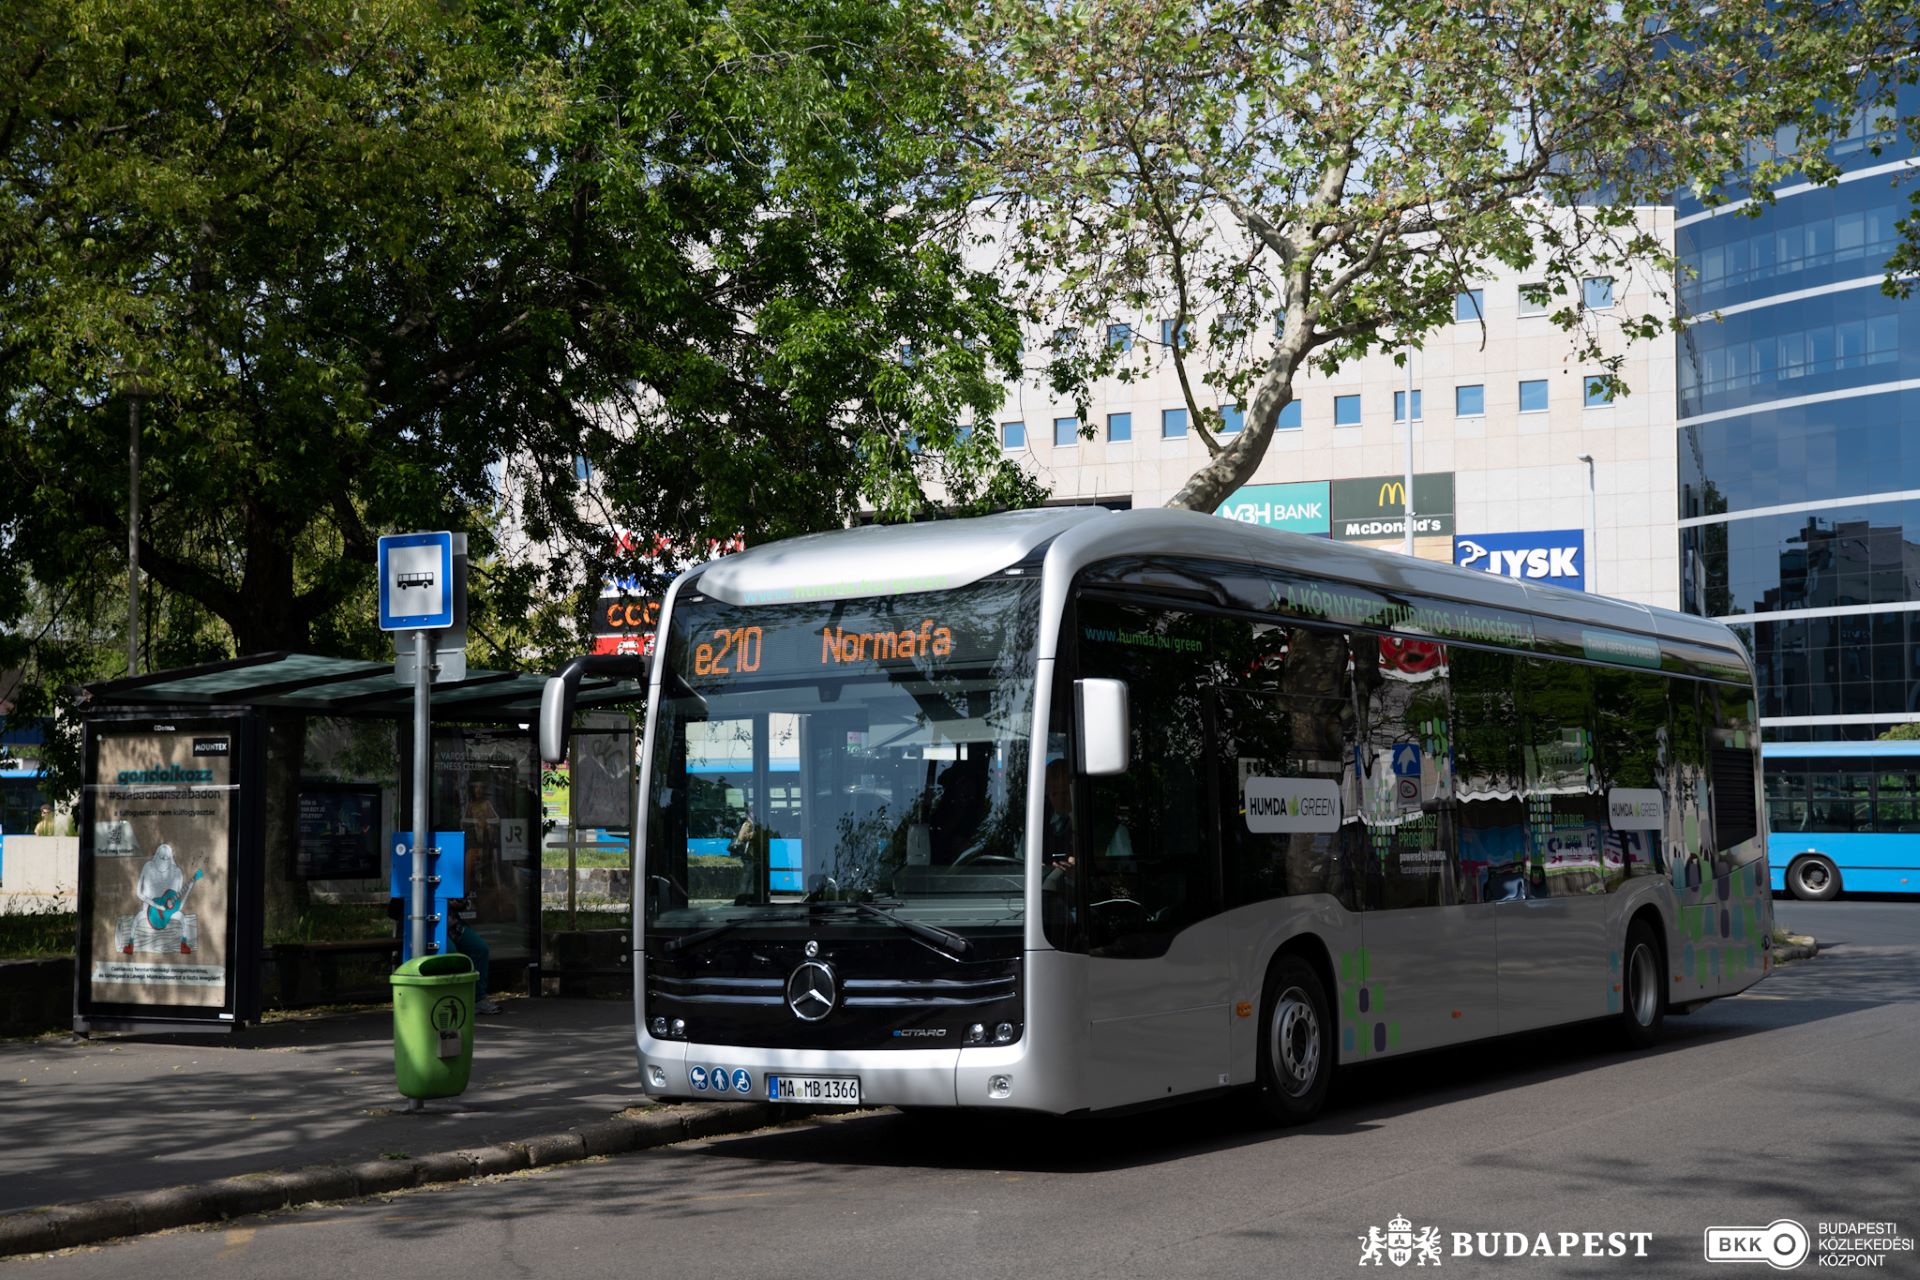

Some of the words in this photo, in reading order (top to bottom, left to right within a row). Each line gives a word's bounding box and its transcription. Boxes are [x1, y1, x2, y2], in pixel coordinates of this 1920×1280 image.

[1223, 502, 1271, 525] MBH
[1274, 502, 1322, 521] BANK
[1346, 519, 1441, 535] McDonld's
[1485, 546, 1579, 578] JYSK
[607, 602, 660, 627] CCC
[1287, 585, 1299, 611] A
[1300, 583, 1452, 634] KÖRNYEZETTUDATOS
[695, 626, 762, 675] e210
[821, 619, 952, 664] Normafa
[1249, 798, 1288, 816] HUMDA
[1301, 798, 1336, 816] GREEN
[1611, 802, 1633, 817] HUMDA
[1641, 802, 1661, 817] GREEN
[780, 1080, 795, 1097] MA
[804, 1081, 820, 1097] MB
[824, 1081, 857, 1098] 1366
